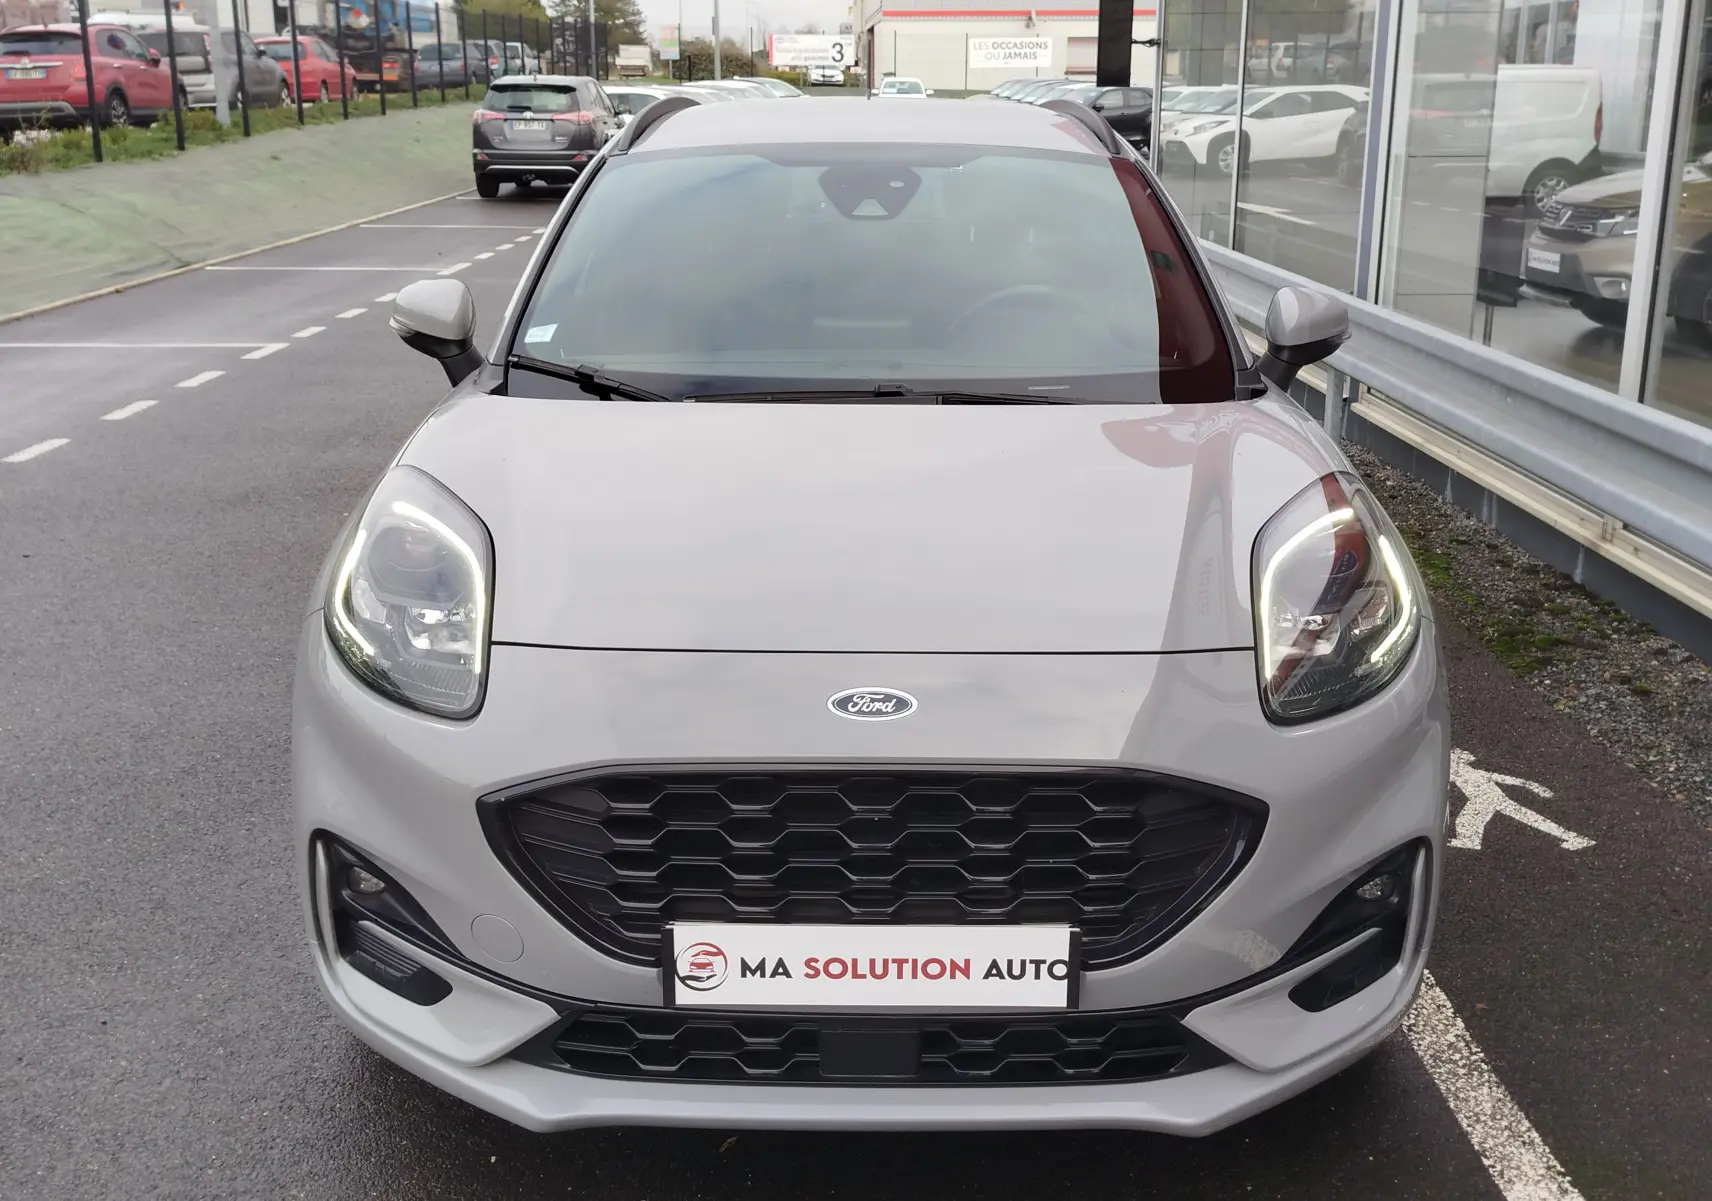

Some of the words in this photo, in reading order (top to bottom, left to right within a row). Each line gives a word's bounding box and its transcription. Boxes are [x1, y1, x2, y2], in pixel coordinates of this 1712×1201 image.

[832, 42, 844, 62] 3
[973, 41, 990, 50] LES
[991, 41, 1048, 50] OCCASIONS
[984, 51, 1000, 60] OU
[1002, 51, 1038, 60] JAMAIS
[847, 693, 897, 713] Ford
[740, 956, 793, 979] MA
[803, 957, 971, 980] SOLUTION
[982, 958, 1068, 981] AUTO
